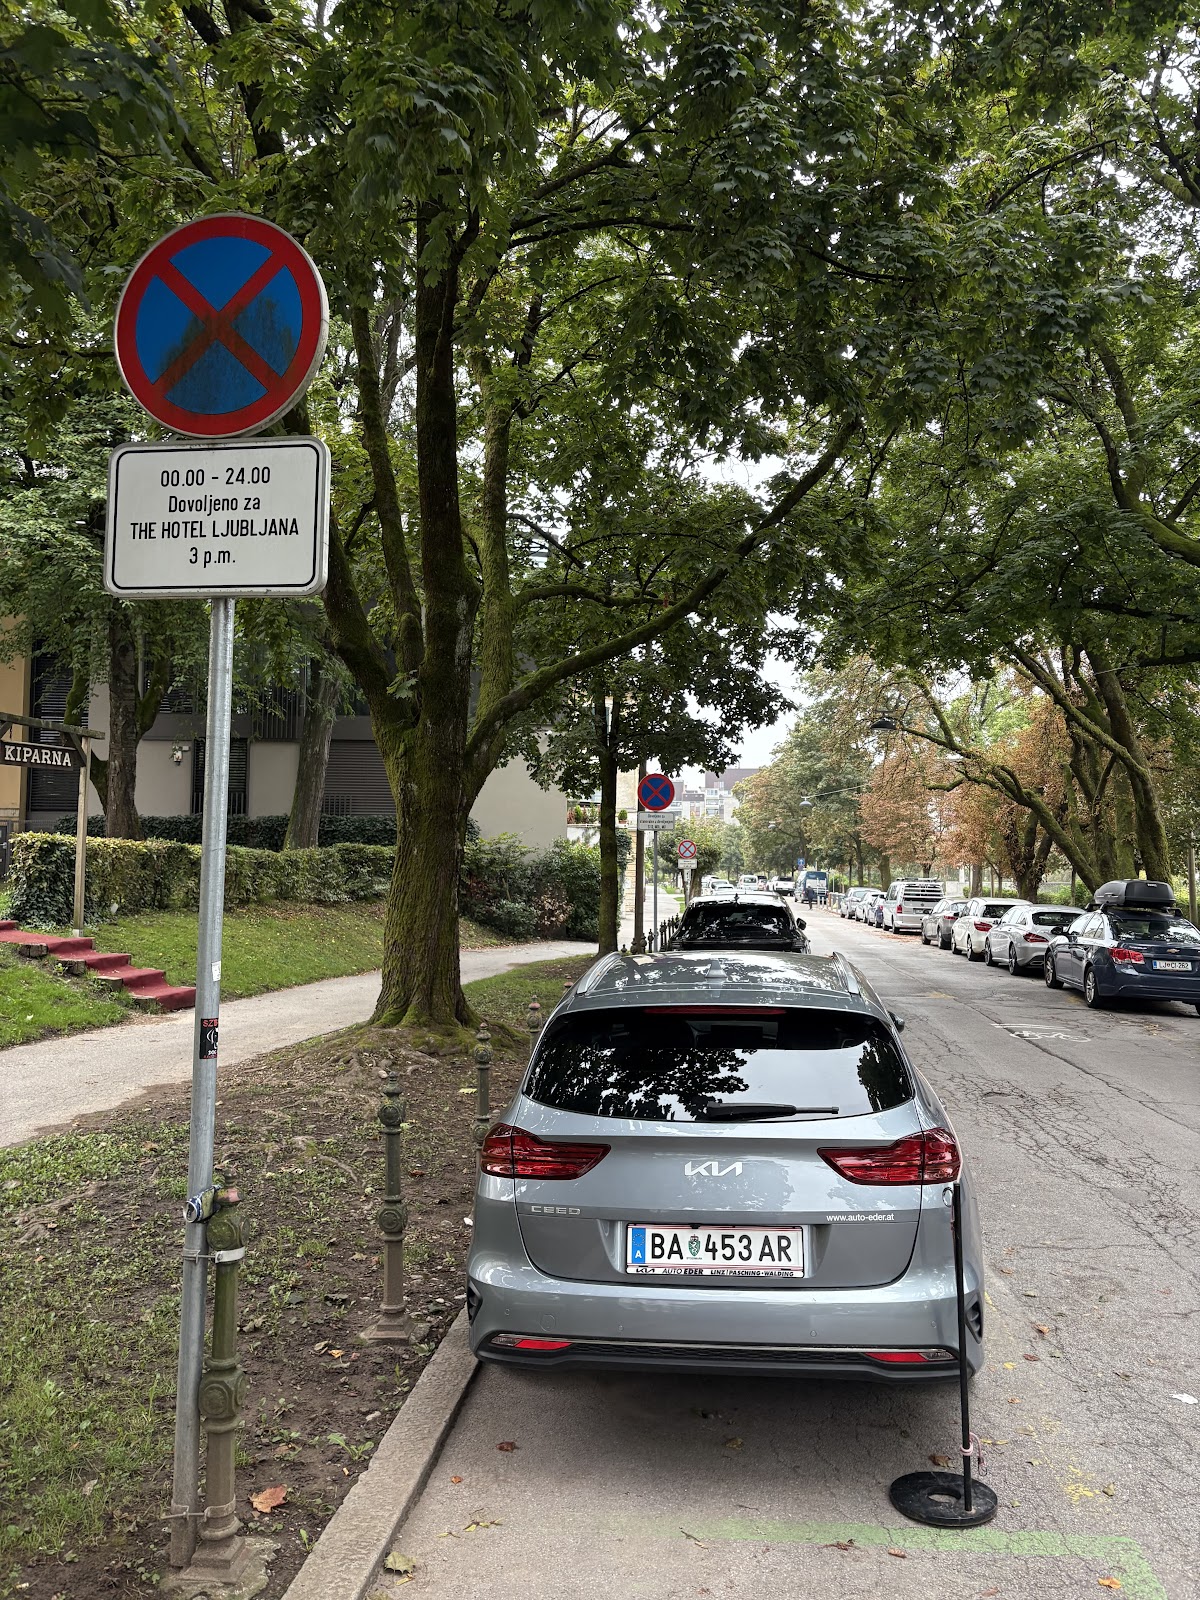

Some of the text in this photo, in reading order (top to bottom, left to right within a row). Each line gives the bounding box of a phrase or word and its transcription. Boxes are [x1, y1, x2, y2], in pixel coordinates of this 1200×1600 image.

[160, 469, 205, 487] 00.00
[225, 466, 271, 485] 24.00
[168, 495, 261, 516] Dovoljeno za
[130, 517, 299, 540] THE HOTEL LJUBLJANA
[189, 547, 236, 568] 3 p.m.
[5, 745, 71, 766] KIPARNA
[684, 1161, 743, 1176] KIA
[531, 1205, 581, 1215] CEED
[826, 1213, 895, 1222] www.auto-eder.at
[634, 1233, 792, 1262] A BA 453 AR
